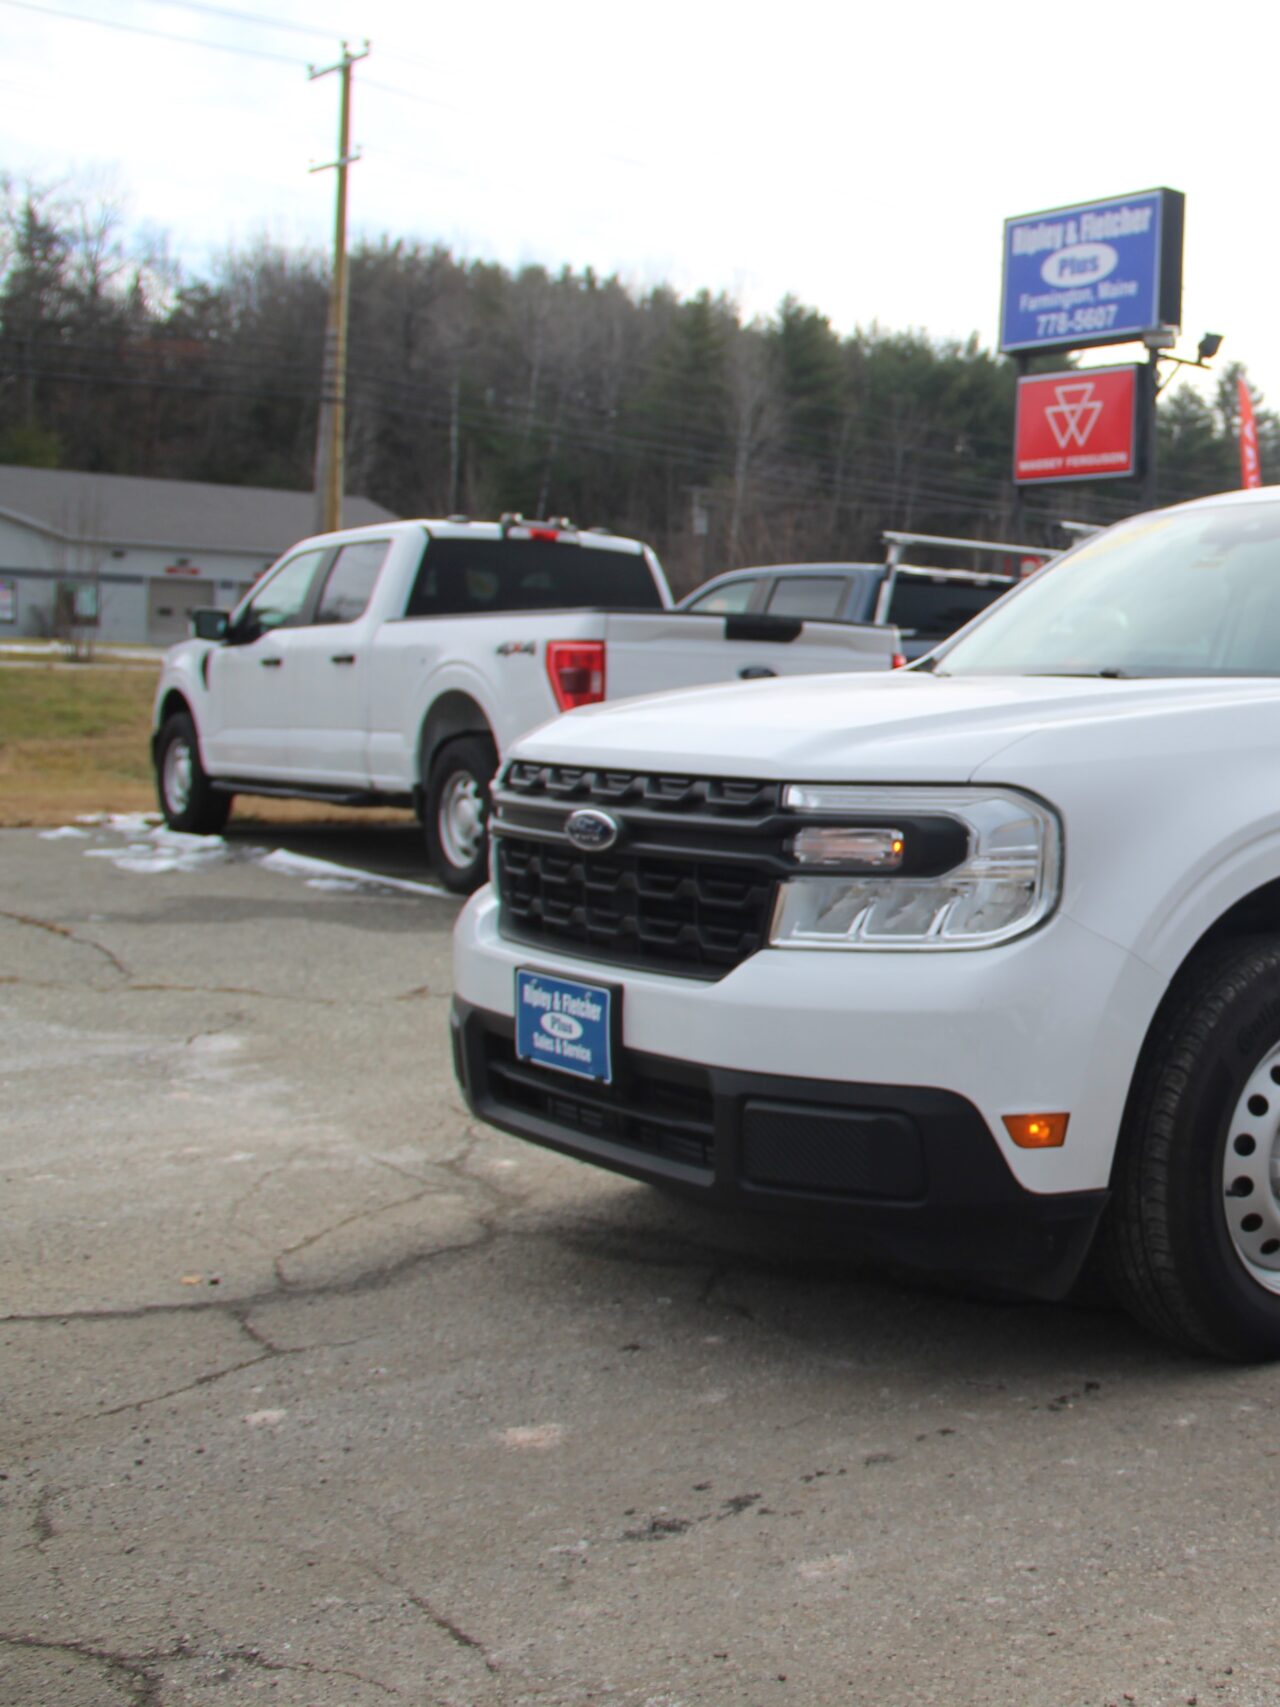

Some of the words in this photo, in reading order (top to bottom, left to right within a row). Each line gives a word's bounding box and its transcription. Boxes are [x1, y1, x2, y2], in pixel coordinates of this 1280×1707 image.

[1012, 222, 1064, 256] Ripley
[1066, 219, 1078, 246] &
[1080, 206, 1153, 243] Fletcher
[1058, 255, 1100, 278] Plus
[1098, 279, 1139, 299] Maine
[523, 983, 552, 1012] Ripley
[553, 991, 562, 1012] &
[562, 993, 602, 1022] Fletcher
[551, 1014, 573, 1035] Plus
[533, 1031, 554, 1053] Sales
[555, 1037, 562, 1055] &
[563, 1039, 592, 1063] Service
